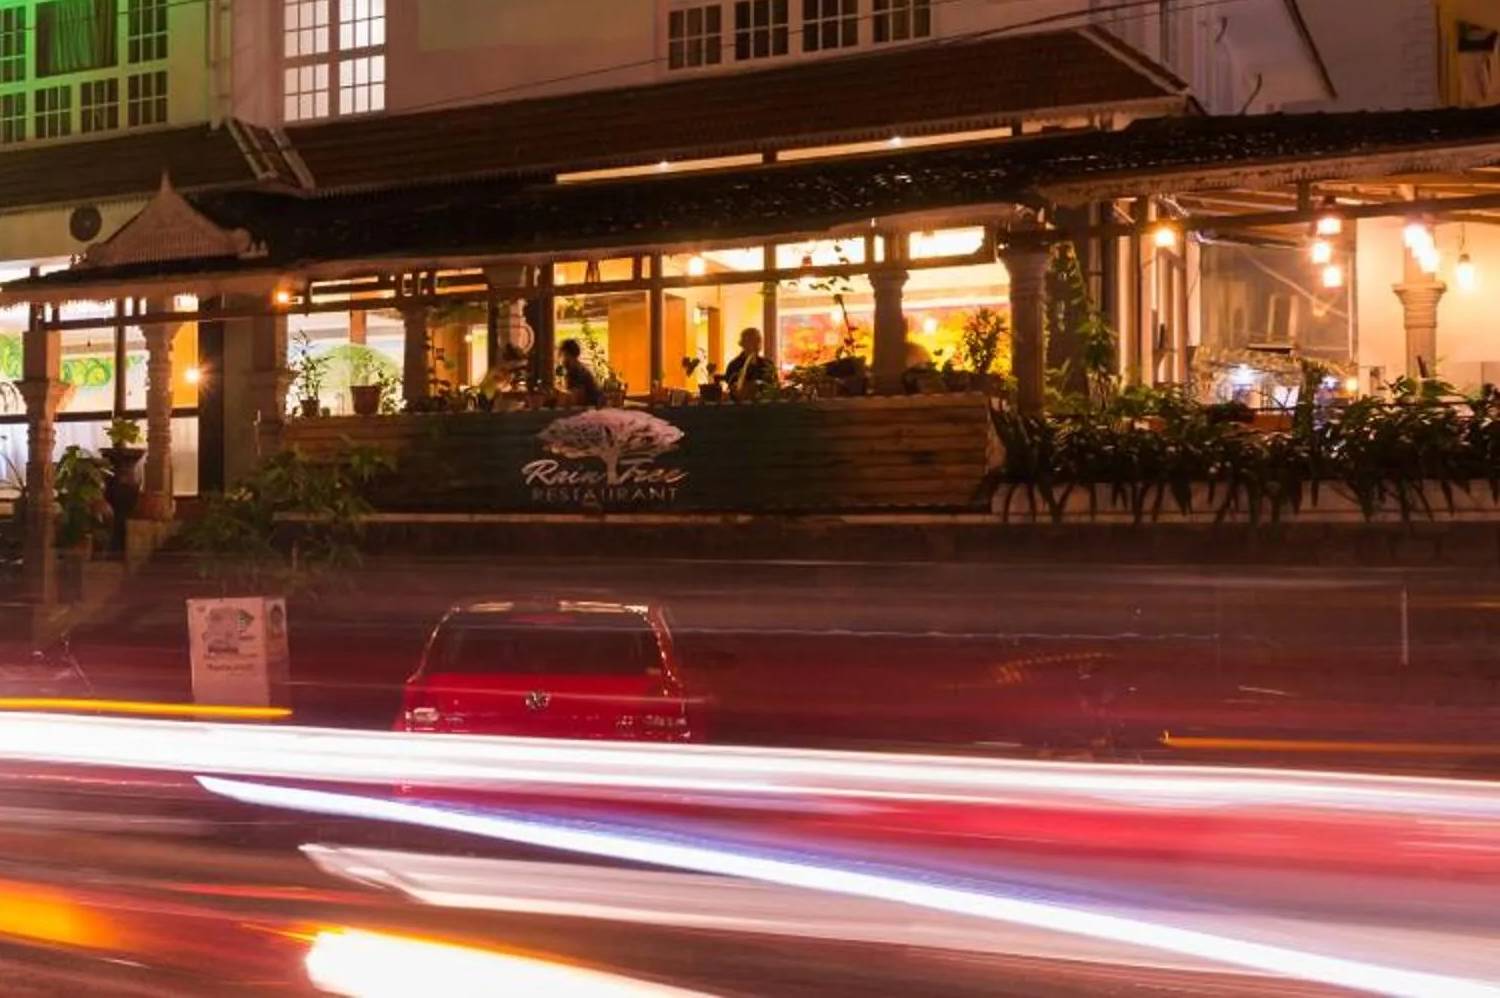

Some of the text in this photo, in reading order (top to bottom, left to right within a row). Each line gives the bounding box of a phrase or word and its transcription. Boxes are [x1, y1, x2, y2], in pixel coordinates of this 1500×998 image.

[521, 457, 689, 485] Rain Tree
[531, 487, 679, 502] RESTAURANT
